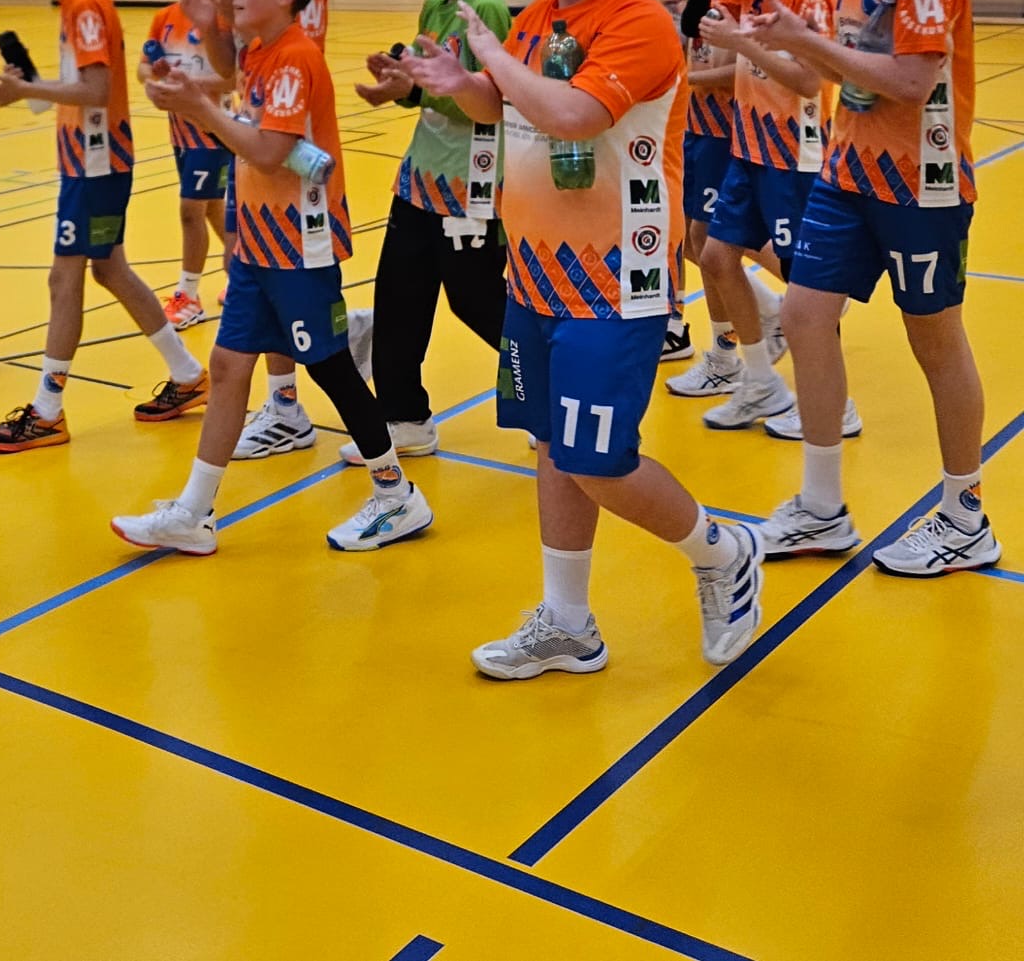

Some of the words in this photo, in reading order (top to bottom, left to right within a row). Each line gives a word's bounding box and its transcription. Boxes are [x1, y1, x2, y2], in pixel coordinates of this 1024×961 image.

[193, 171, 209, 191] 7
[925, 162, 954, 184] M
[470, 181, 493, 199] M
[630, 179, 661, 205] M
[703, 187, 719, 213] 2
[59, 220, 76, 246] 3
[306, 212, 324, 229] M
[775, 218, 792, 247] 5
[630, 267, 661, 293] M
[889, 250, 939, 294] 17
[630, 292, 662, 301] Meinhardt
[291, 320, 312, 352] 6
[510, 339, 526, 401] GRAMENZ
[560, 396, 614, 454] 11
